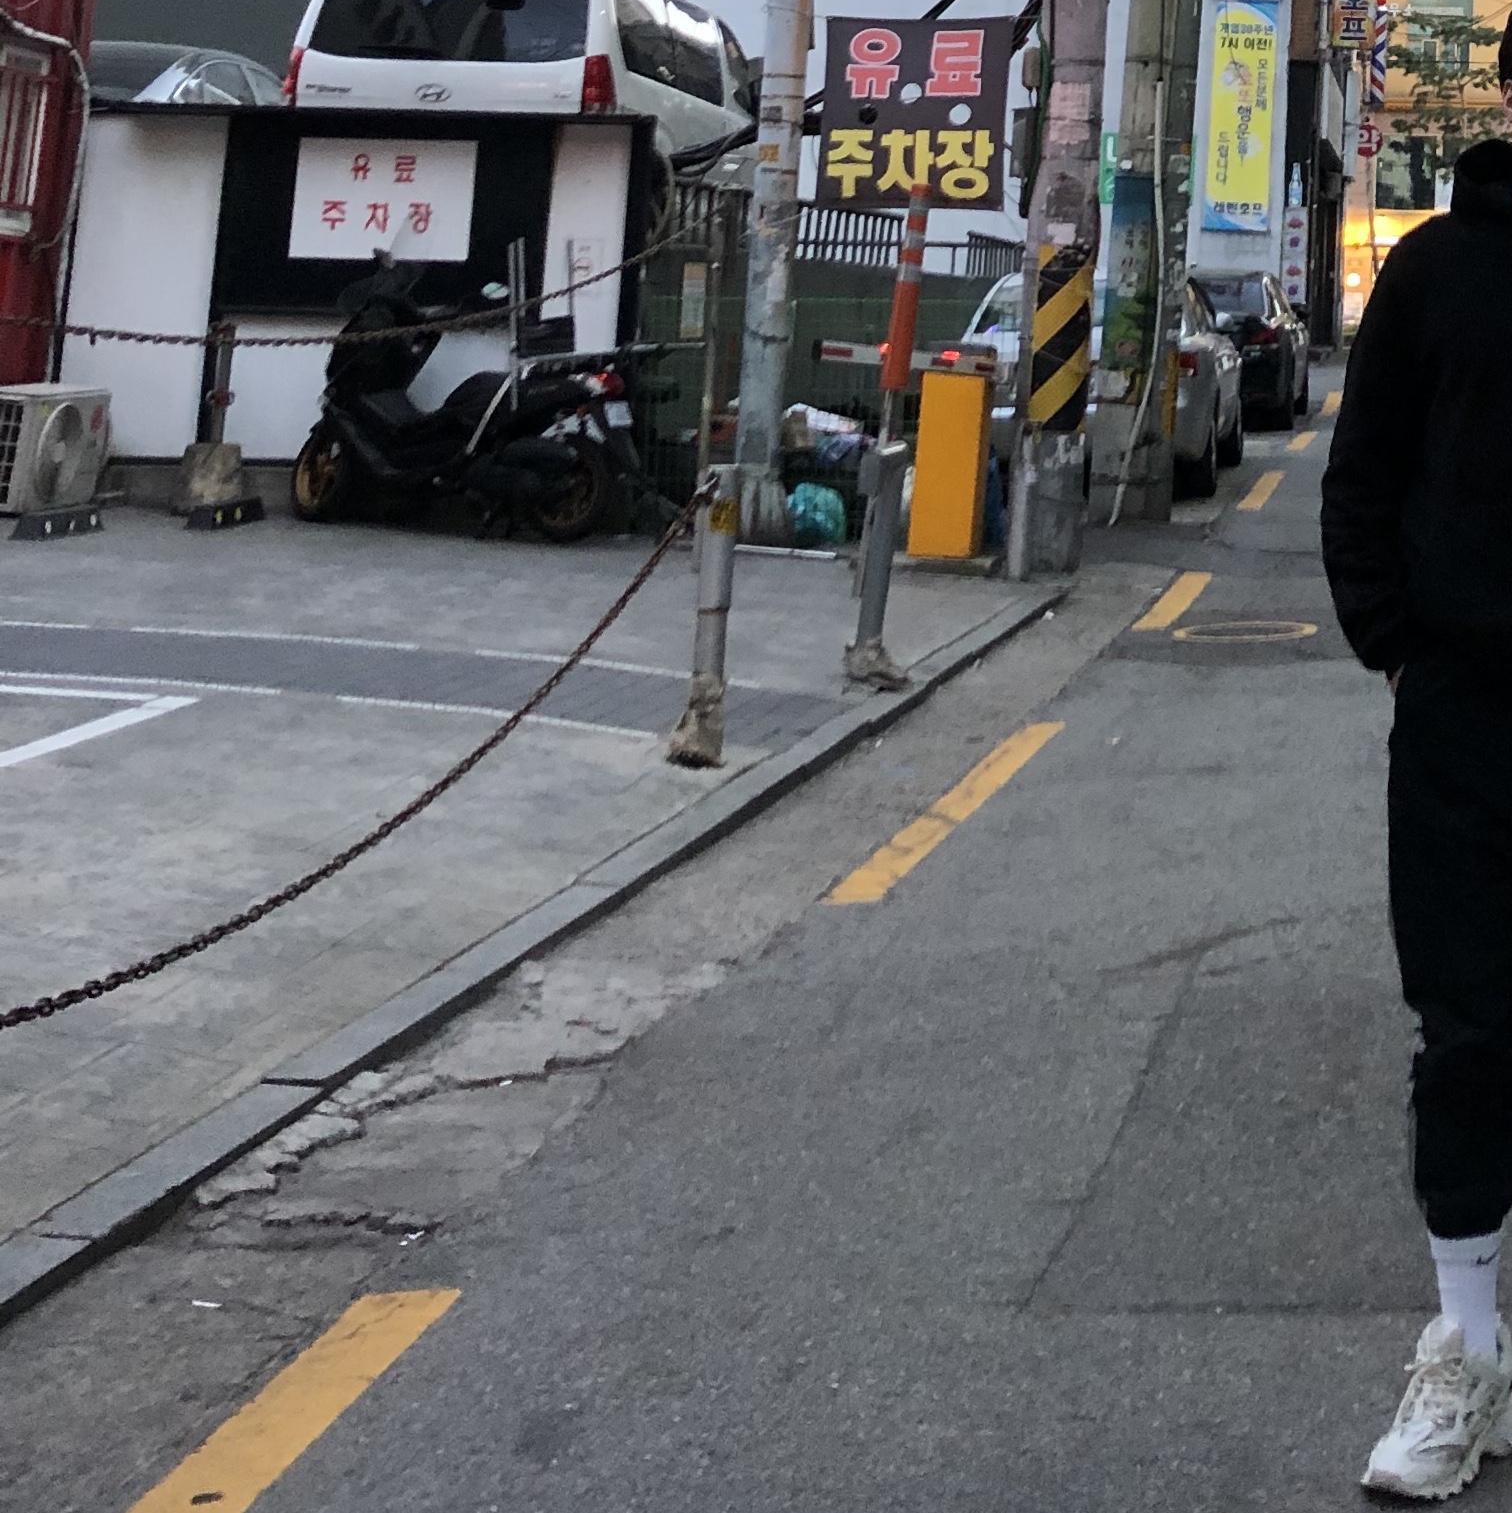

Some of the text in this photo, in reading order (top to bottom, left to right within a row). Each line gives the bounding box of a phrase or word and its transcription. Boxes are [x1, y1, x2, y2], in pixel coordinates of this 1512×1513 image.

[846, 28, 985, 99] 유료
[351, 153, 417, 183] 유료
[826, 129, 994, 200] 주차장
